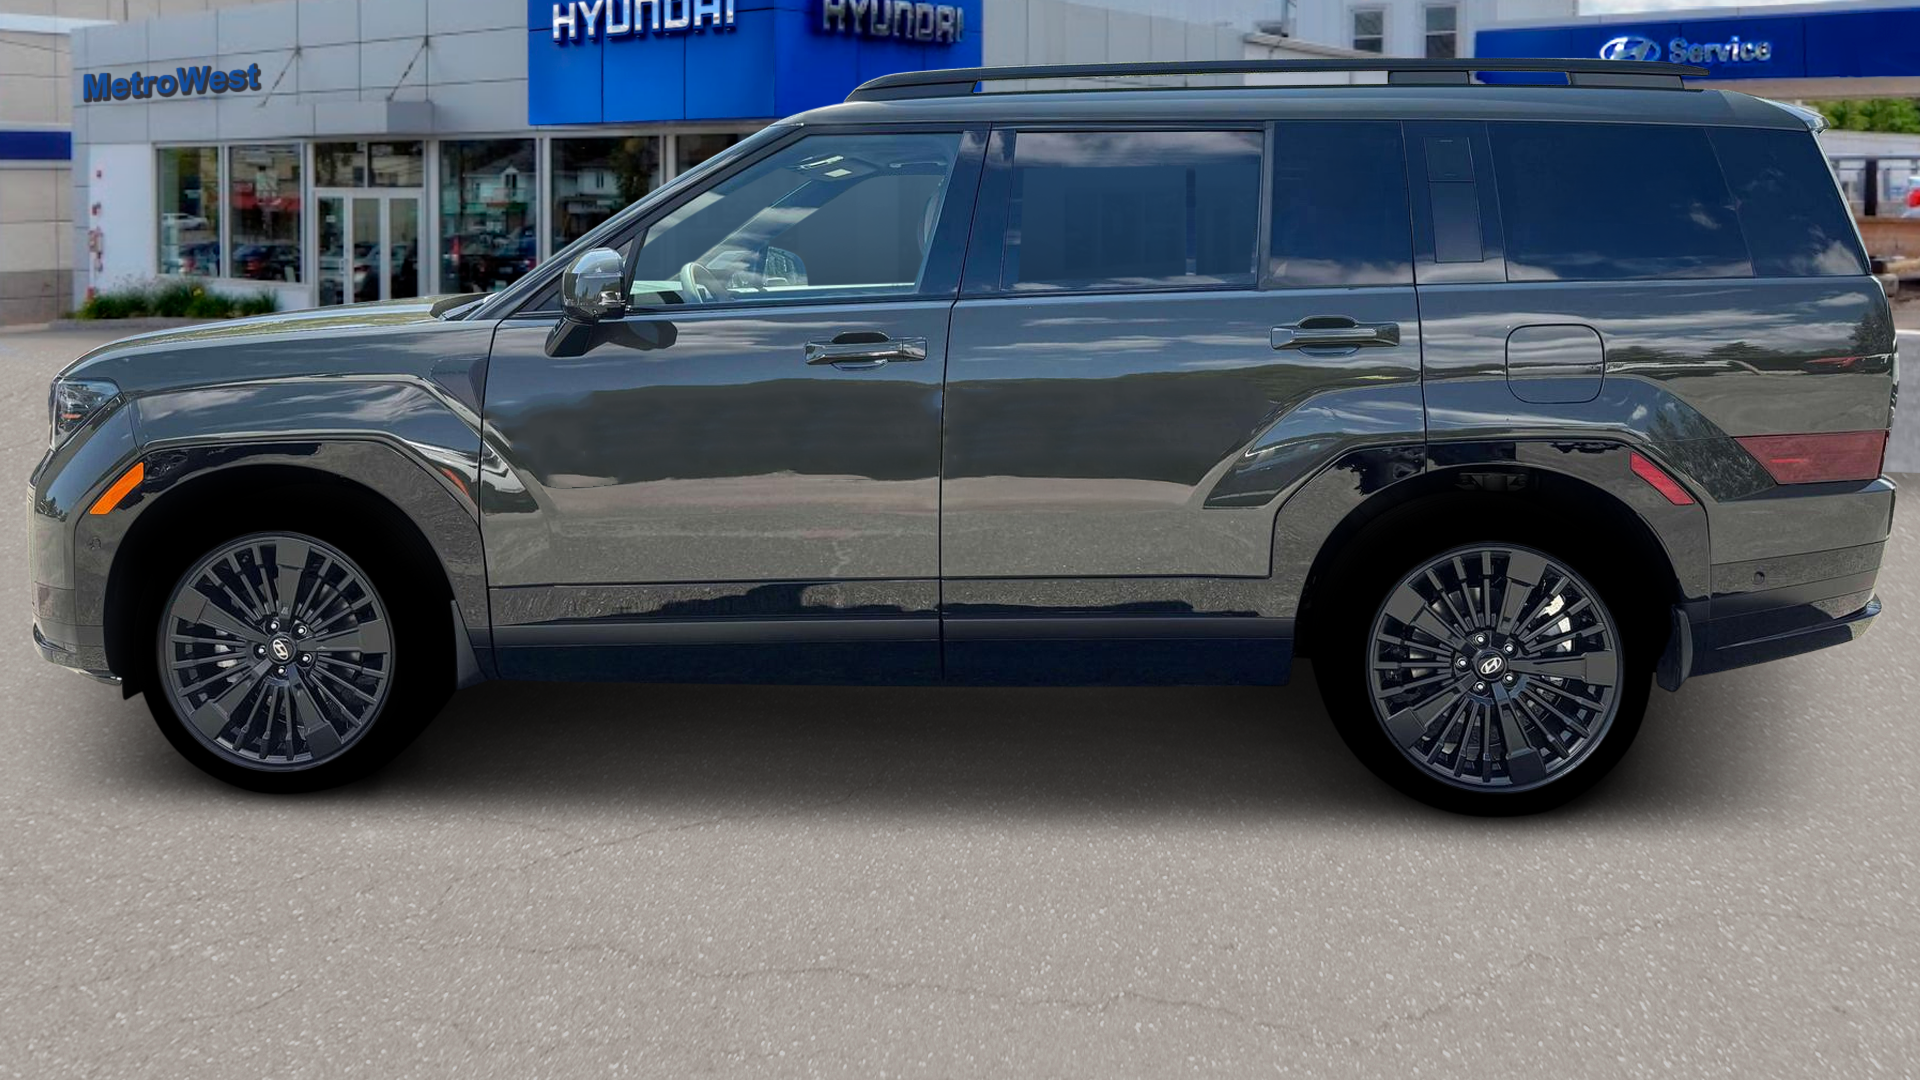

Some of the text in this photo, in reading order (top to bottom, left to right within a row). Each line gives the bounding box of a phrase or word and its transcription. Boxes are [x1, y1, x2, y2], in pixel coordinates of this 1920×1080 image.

[552, 0, 735, 40] HYUNDAI
[823, 0, 965, 43] HYUNDAI
[1669, 35, 1771, 63] Service
[83, 63, 262, 102] MetroWest
